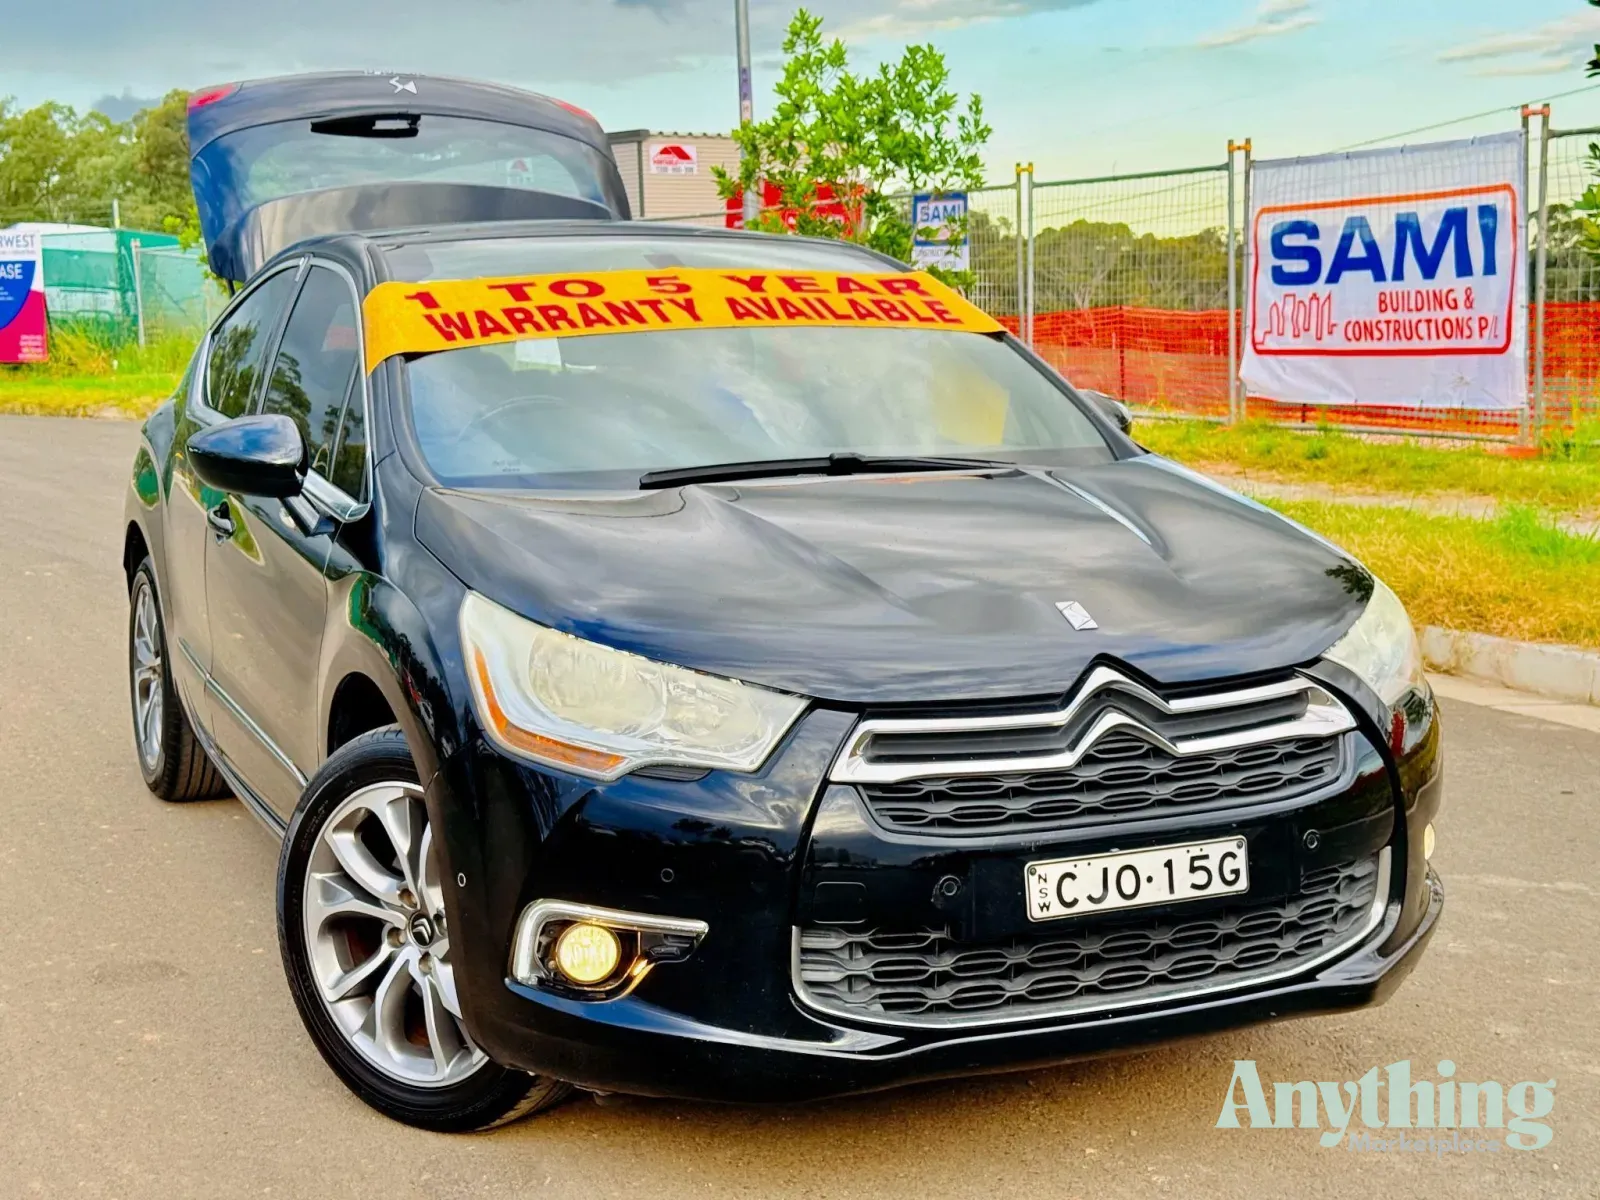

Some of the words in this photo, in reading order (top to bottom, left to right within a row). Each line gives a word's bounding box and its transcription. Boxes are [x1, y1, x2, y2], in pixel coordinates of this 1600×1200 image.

[920, 204, 960, 222] SAMI
[1270, 204, 1497, 286] SAMI
[404, 291, 442, 309] 1
[487, 279, 606, 302] TO
[645, 275, 692, 294] 5
[721, 275, 933, 297] YEAR
[1378, 288, 1459, 313] BUILDING
[1463, 286, 1475, 310] &
[423, 297, 704, 342] WARRANTY
[725, 297, 965, 325] AVAILABLE
[1344, 316, 1473, 342] CONSTRUCTIONS
